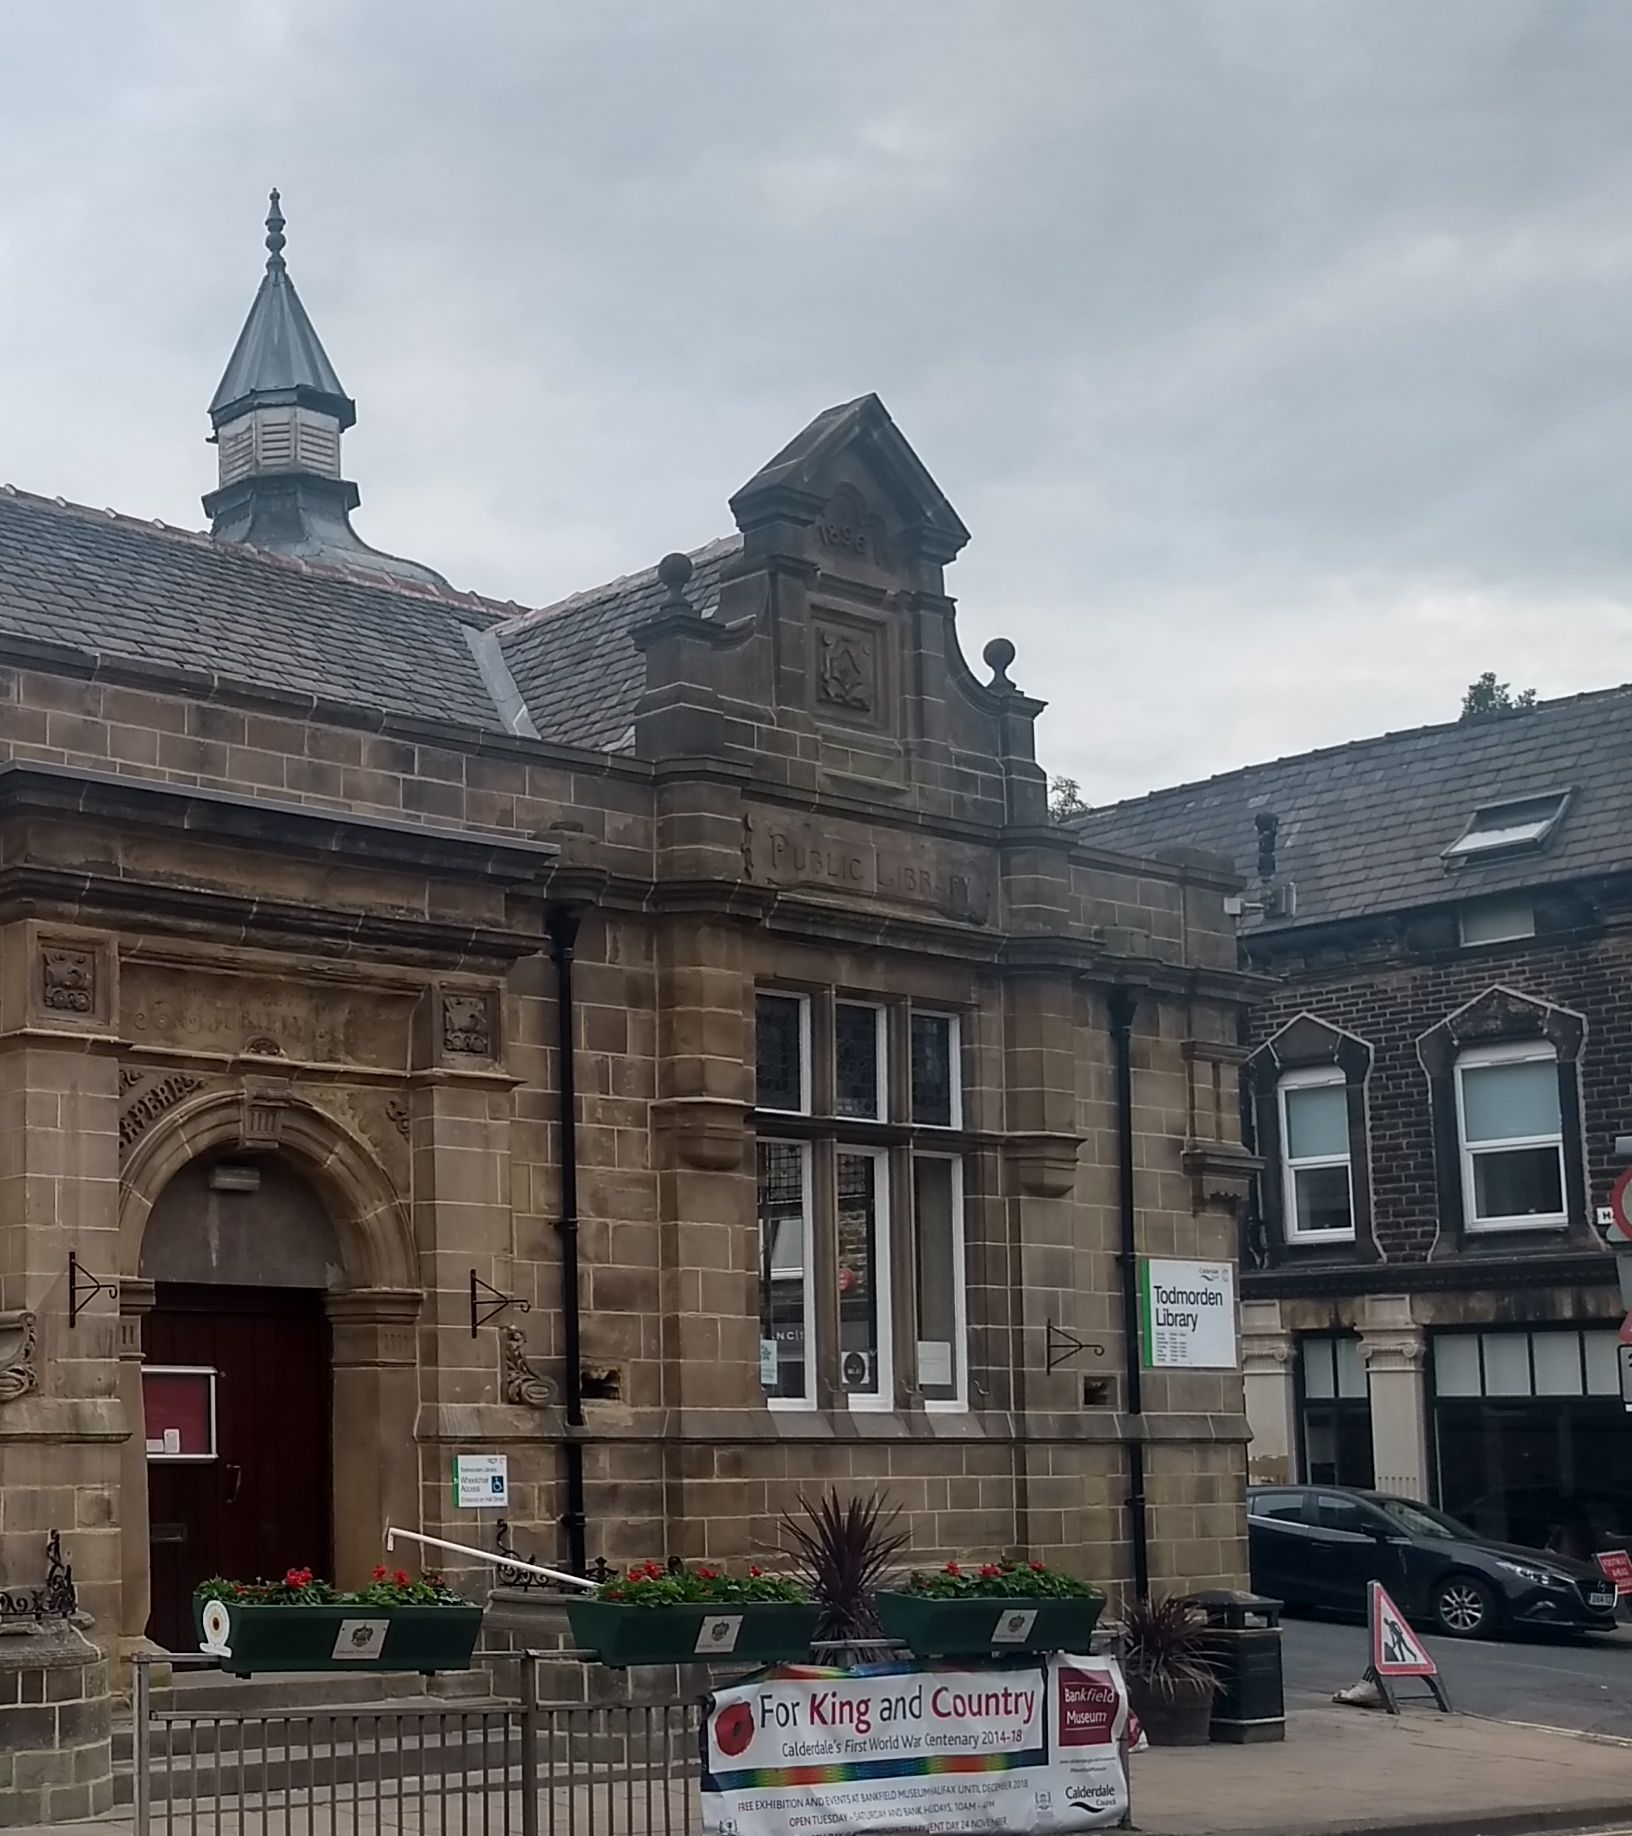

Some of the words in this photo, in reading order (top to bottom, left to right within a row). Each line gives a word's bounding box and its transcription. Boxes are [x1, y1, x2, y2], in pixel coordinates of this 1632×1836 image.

[1153, 1285, 1223, 1306] Todmorden
[1156, 1308, 1198, 1332] Library
[1064, 1687, 1114, 1703] Bankfield
[759, 1694, 800, 1728] For
[809, 1691, 871, 1734] King
[879, 1684, 922, 1722] and
[931, 1686, 1035, 1724] Country
[1066, 1710, 1107, 1725] Museum
[782, 1740, 842, 1757] Calderdale's
[844, 1738, 868, 1753] First
[869, 1735, 899, 1751] World
[901, 1735, 922, 1750] War
[924, 1731, 980, 1749] Centenary
[982, 1730, 1023, 1746] 2014-18
[738, 1801, 754, 1812] FREE
[755, 1798, 803, 1811] EXHIBITION
[804, 1797, 825, 1808] AND
[825, 1794, 851, 1806] EVENTS
[851, 1793, 860, 1803] AT
[860, 1789, 897, 1803] BANKFIELD
[958, 1783, 981, 1795] UNTIL
[1012, 1778, 1028, 1790] 2018
[1065, 1784, 1115, 1799] Calderdale
[1096, 1798, 1116, 1806] Council
[789, 1815, 812, 1827] OPEN
[812, 1813, 848, 1826] TUESDAY
[853, 1809, 887, 1822] SATURDAY
[903, 1805, 923, 1817] BANK
[954, 1801, 977, 1812] 10AM
[946, 1820, 960, 1830] DAY
[971, 1816, 1008, 1828] NOVEMBER
